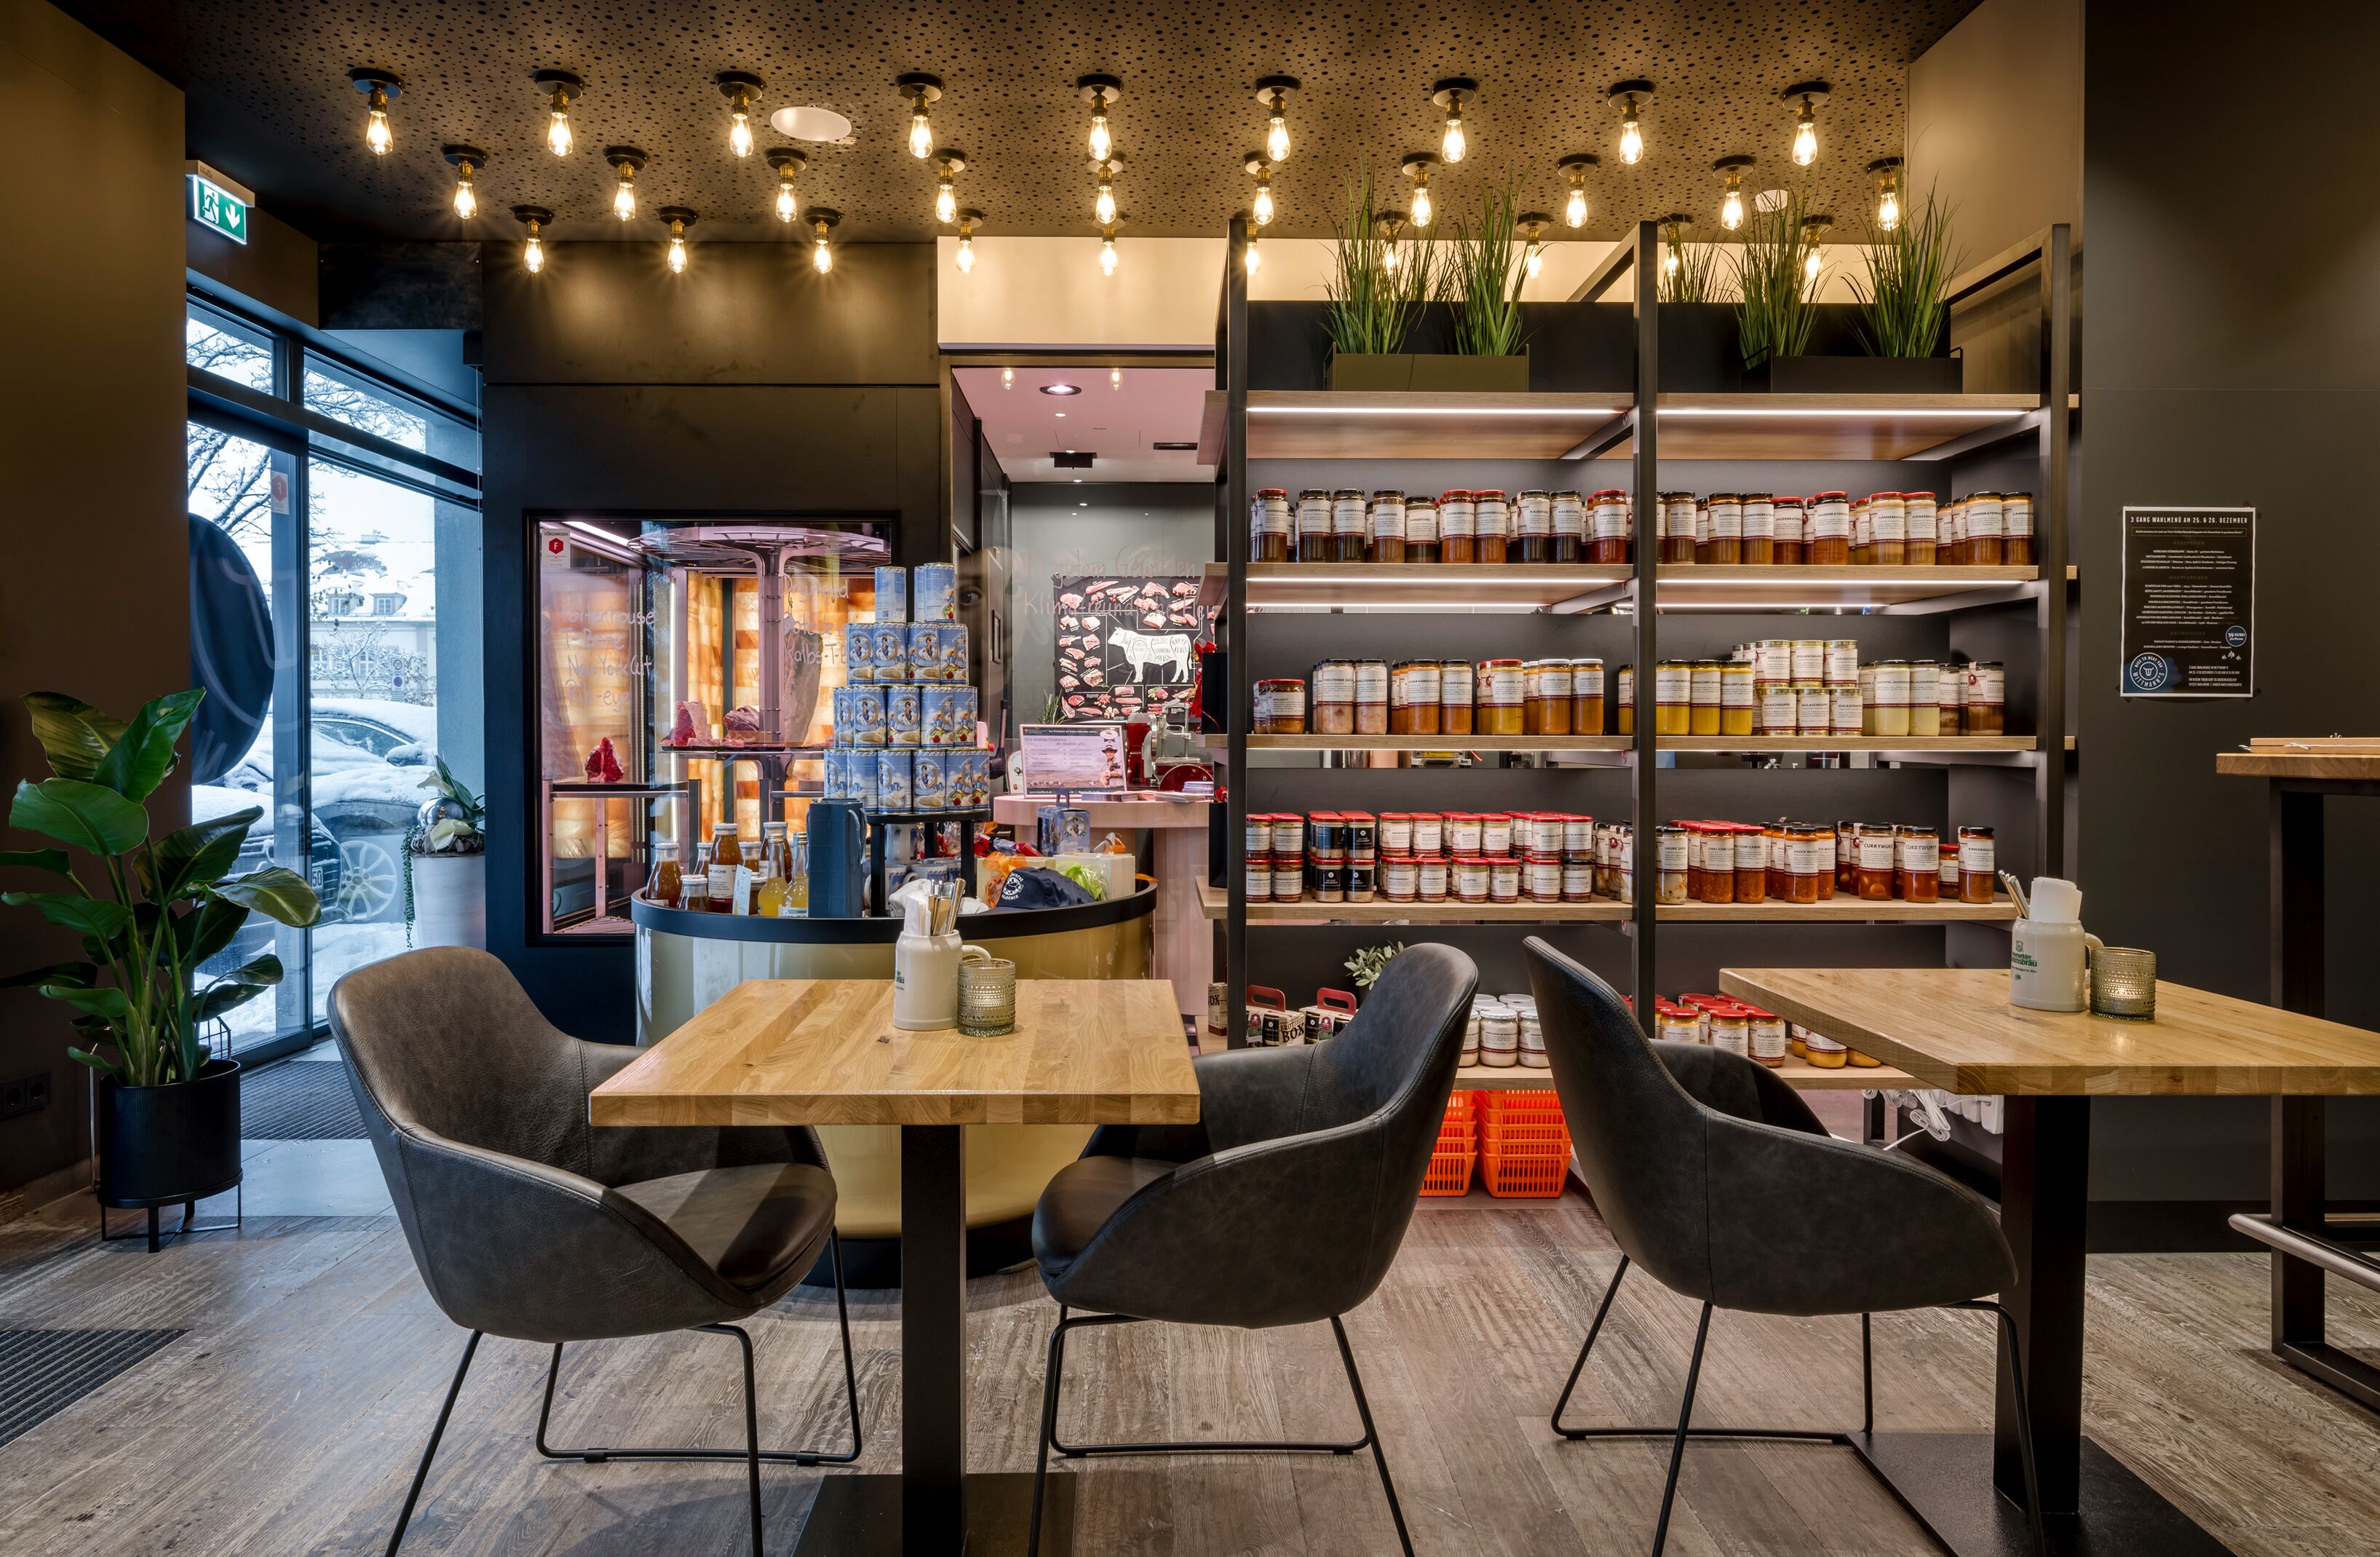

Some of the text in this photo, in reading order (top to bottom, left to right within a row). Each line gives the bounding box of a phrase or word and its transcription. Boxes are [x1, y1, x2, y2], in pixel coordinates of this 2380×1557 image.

[554, 542, 558, 550] F
[599, 655, 628, 676] York
[1281, 1021, 1305, 1043] BOX
